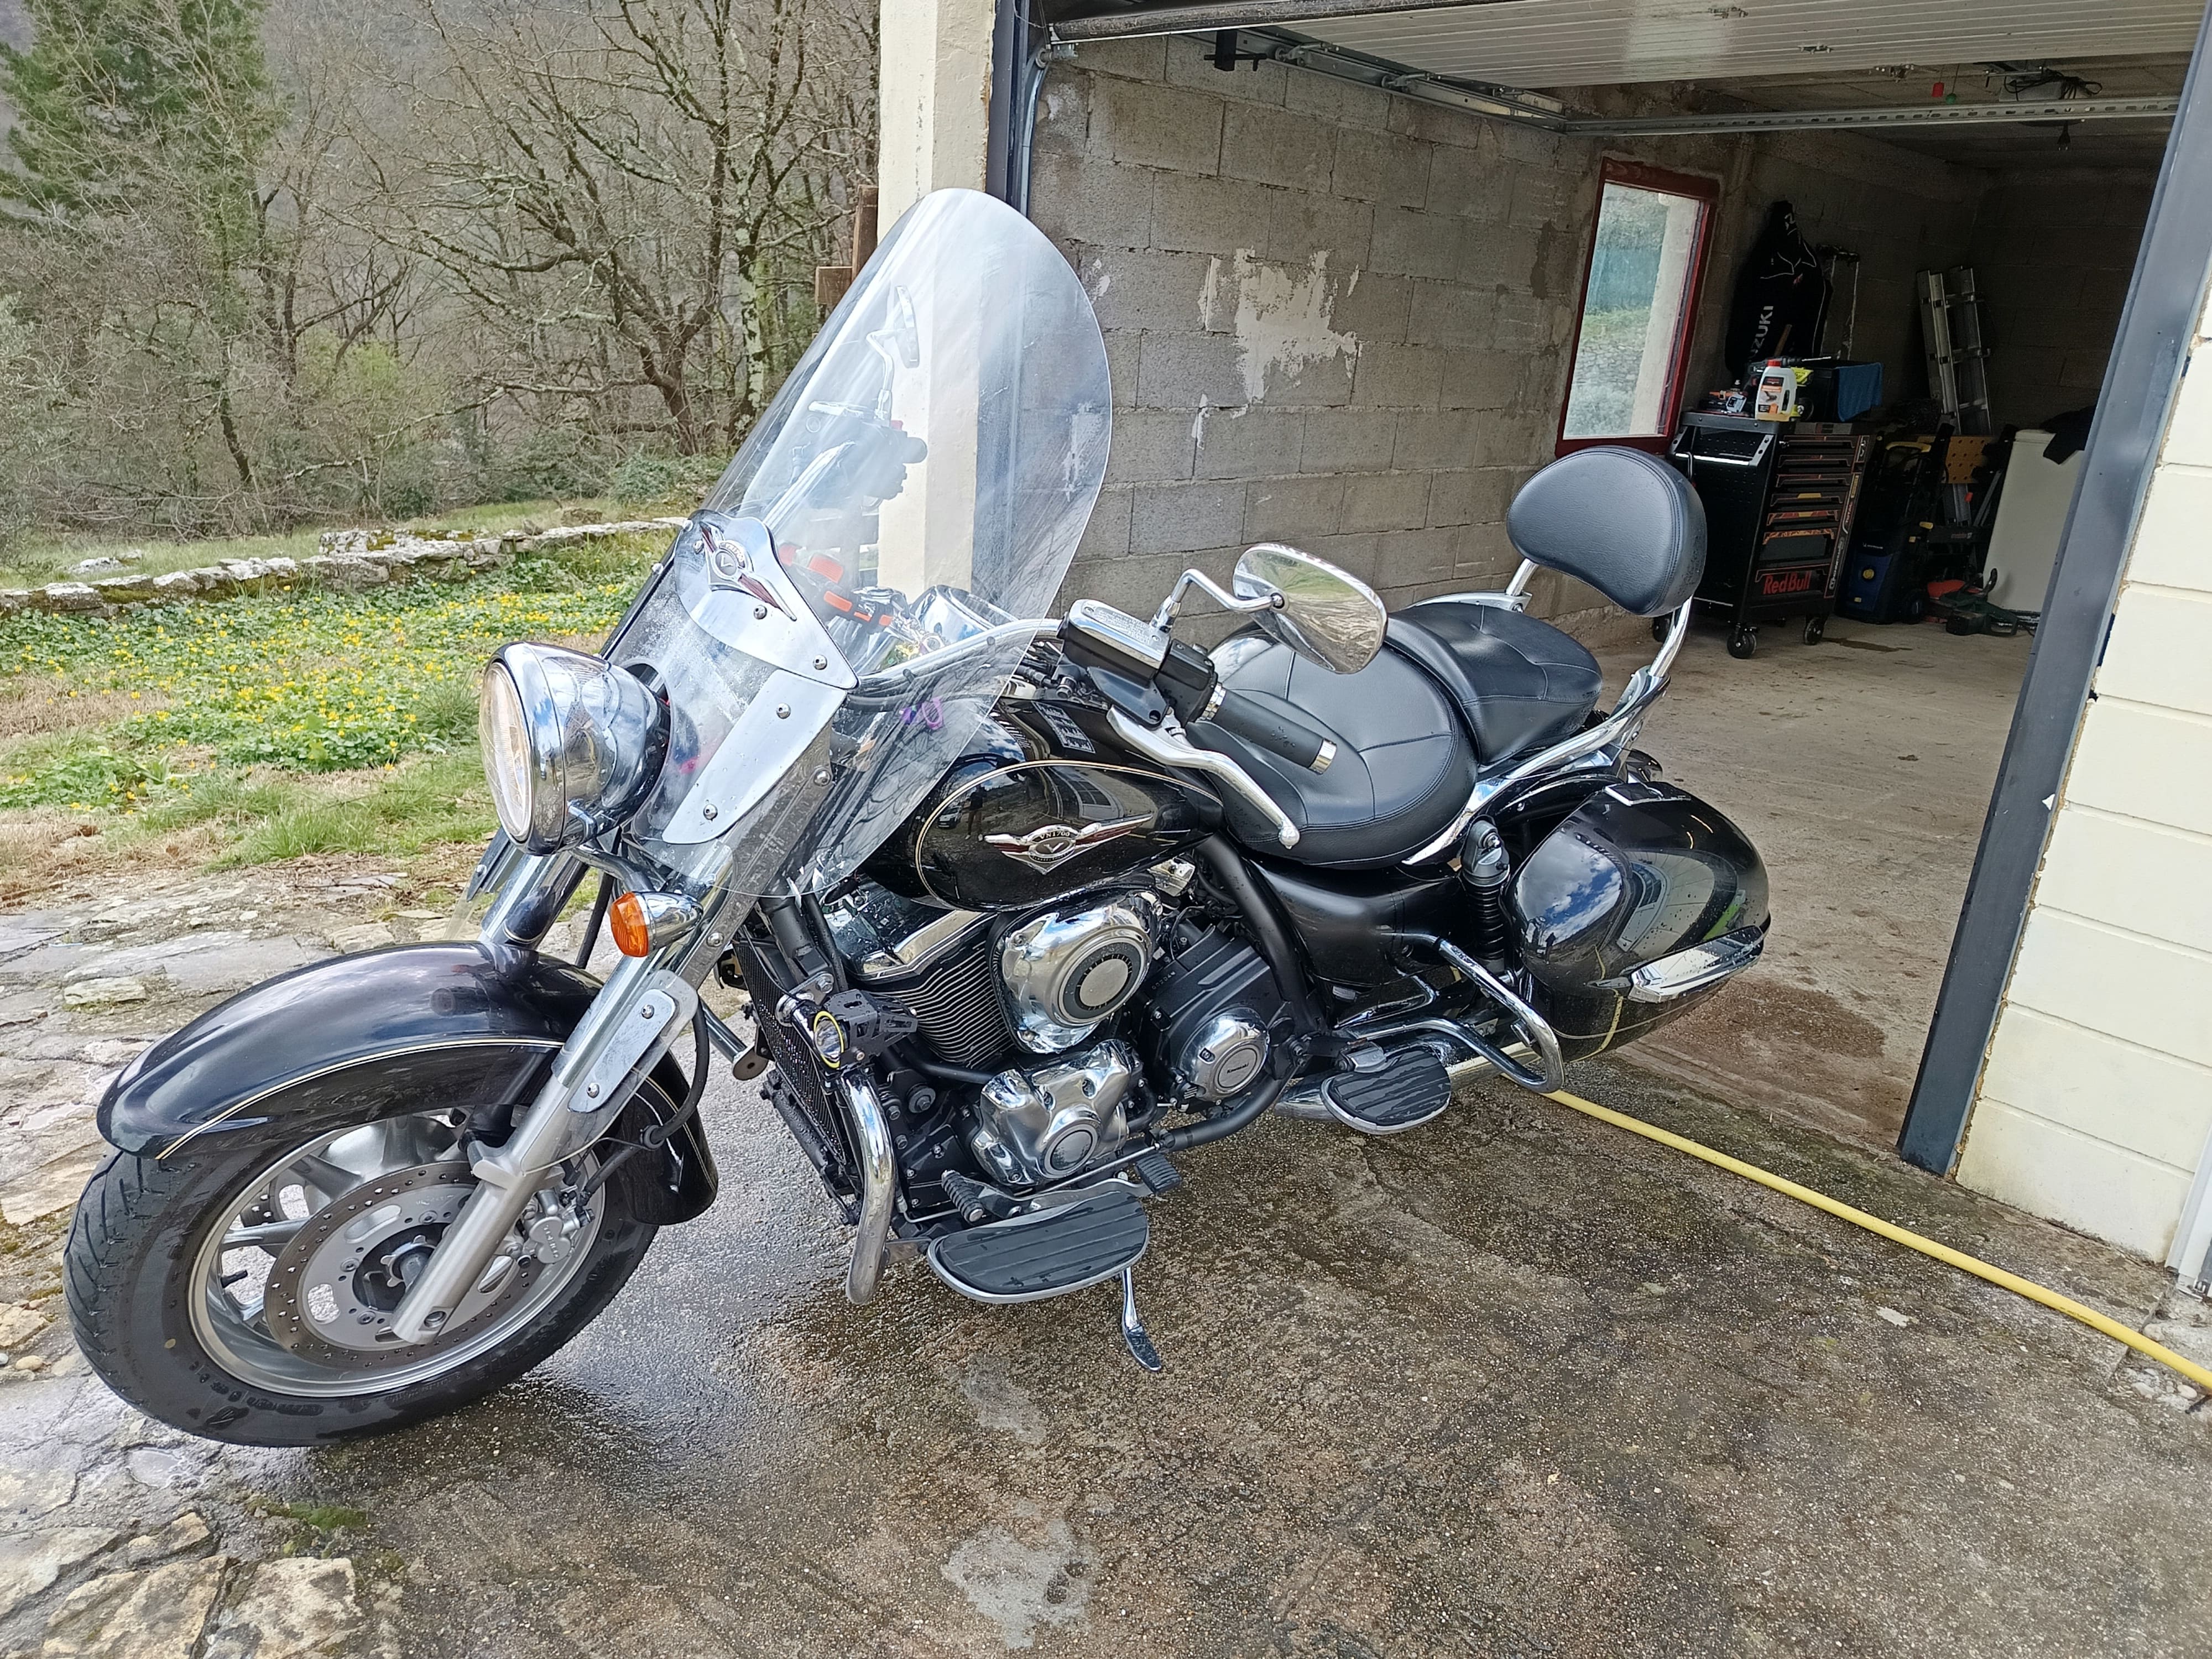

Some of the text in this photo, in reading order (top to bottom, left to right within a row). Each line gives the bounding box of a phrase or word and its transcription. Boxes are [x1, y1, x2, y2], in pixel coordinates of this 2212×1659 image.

[1747, 305, 1774, 361] UZUKI
[1039, 831, 1070, 839] VN1700
[1227, 1062, 1249, 1074] Kawasaki
